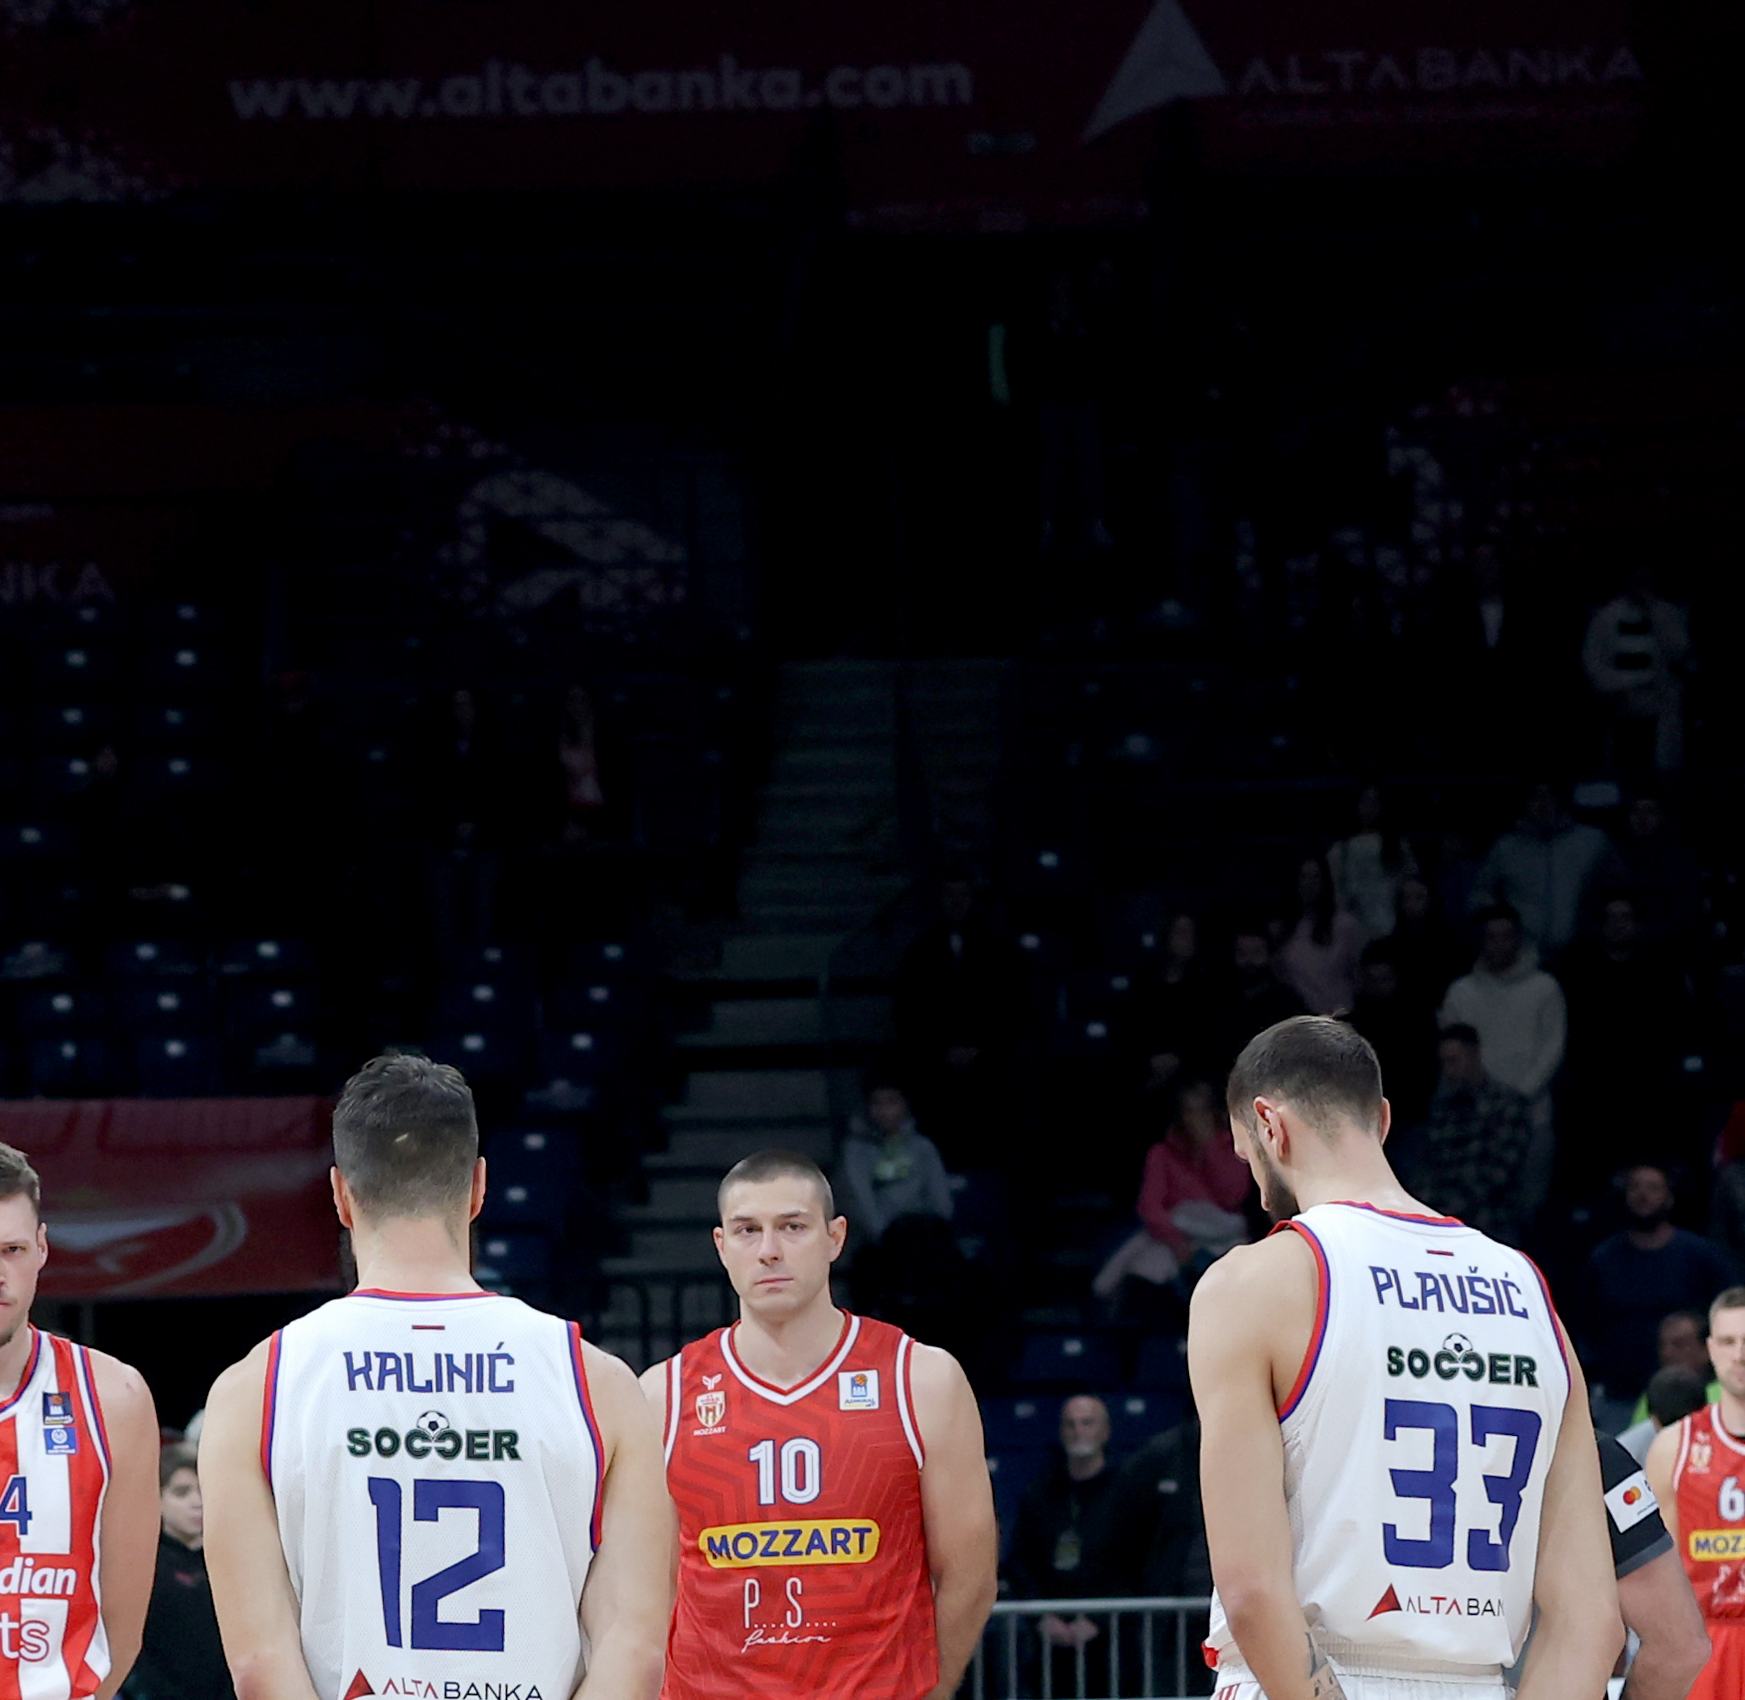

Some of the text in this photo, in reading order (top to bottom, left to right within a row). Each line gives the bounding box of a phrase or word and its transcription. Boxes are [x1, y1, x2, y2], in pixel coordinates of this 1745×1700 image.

[228, 53, 974, 118] www.altabanka.com
[1236, 46, 1645, 96] ALTABANKA
[1368, 1266, 1529, 1319] PLAVŠIĆ
[343, 1341, 515, 1394] KALINIĆ
[748, 1437, 822, 1505] 10
[1381, 1397, 1543, 1573] 33
[367, 1476, 505, 1653] 12
[707, 1527, 873, 1561] MOZZART
